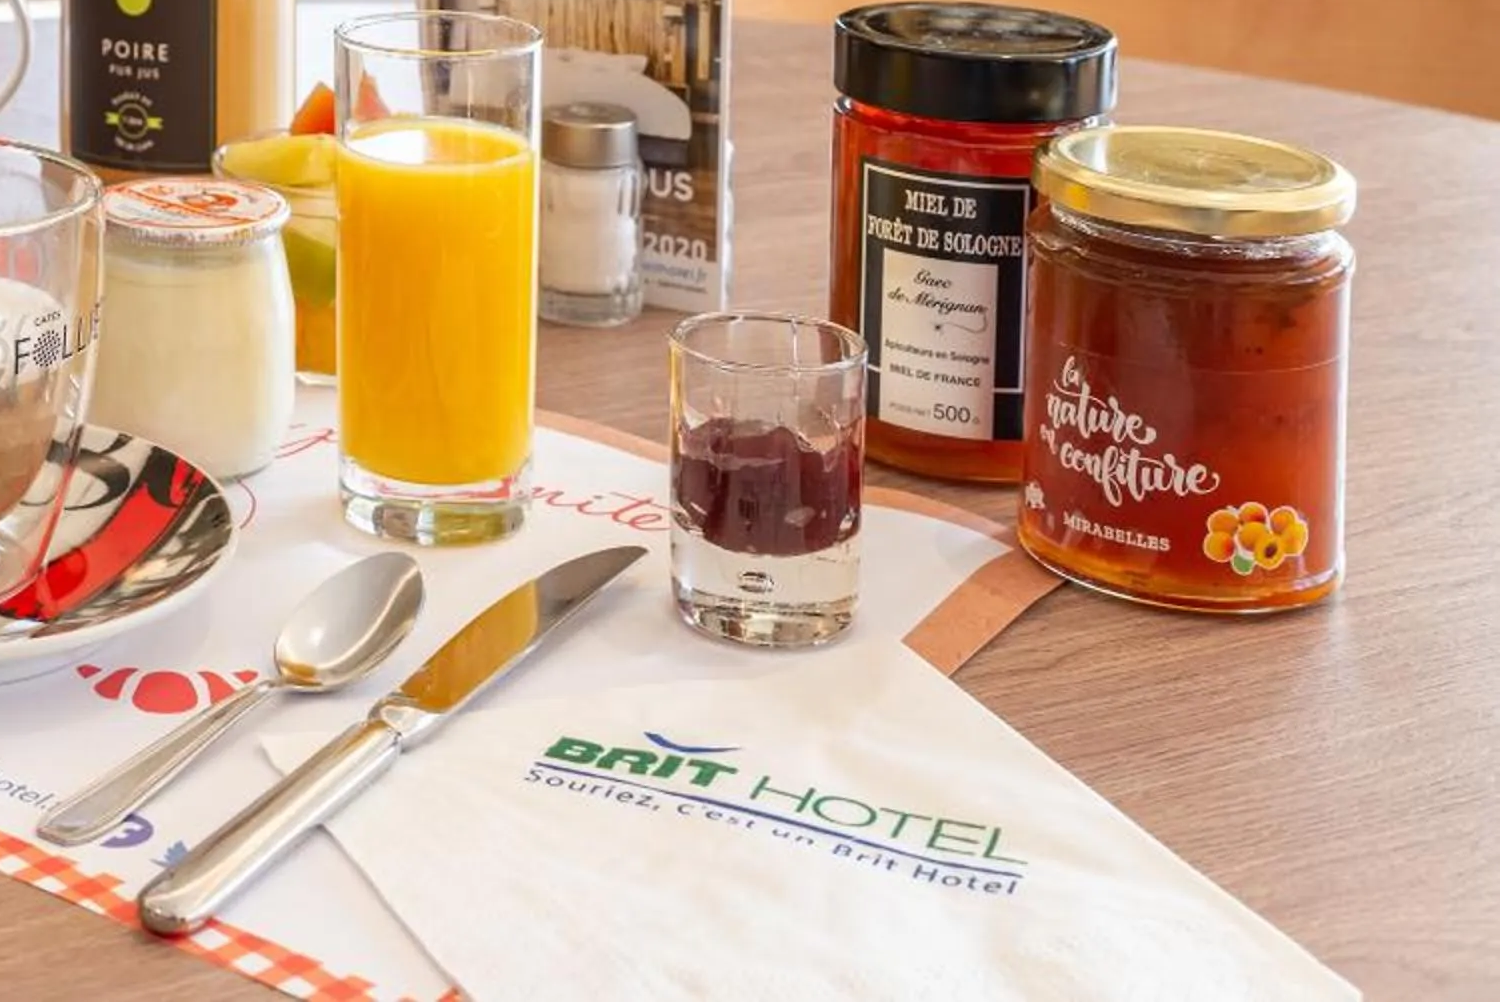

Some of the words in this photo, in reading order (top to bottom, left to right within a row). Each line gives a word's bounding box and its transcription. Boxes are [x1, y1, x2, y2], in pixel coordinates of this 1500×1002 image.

[101, 38, 170, 63] POIRE
[108, 63, 133, 77] PUR
[137, 67, 160, 80] JUS
[649, 167, 694, 202] US
[905, 189, 949, 216] MIEL
[953, 198, 977, 219] DE
[643, 232, 707, 262] 2020
[867, 215, 912, 245] FORÊT
[917, 227, 939, 249] DE
[943, 231, 1022, 257] SOLOGNE
[934, 373, 981, 387] FRANCE
[1062, 355, 1081, 387] la
[933, 403, 971, 424] 500
[1046, 382, 1157, 445] nature
[1060, 442, 1221, 508] confiture
[1063, 511, 1171, 552] MIRABELLES
[545, 736, 739, 788] BRIT
[749, 775, 1029, 865] HOTEL
[524, 768, 660, 811] Souriez,
[771, 828, 815, 847] un
[832, 843, 899, 871] Brit
[912, 864, 1017, 895] Hotel
